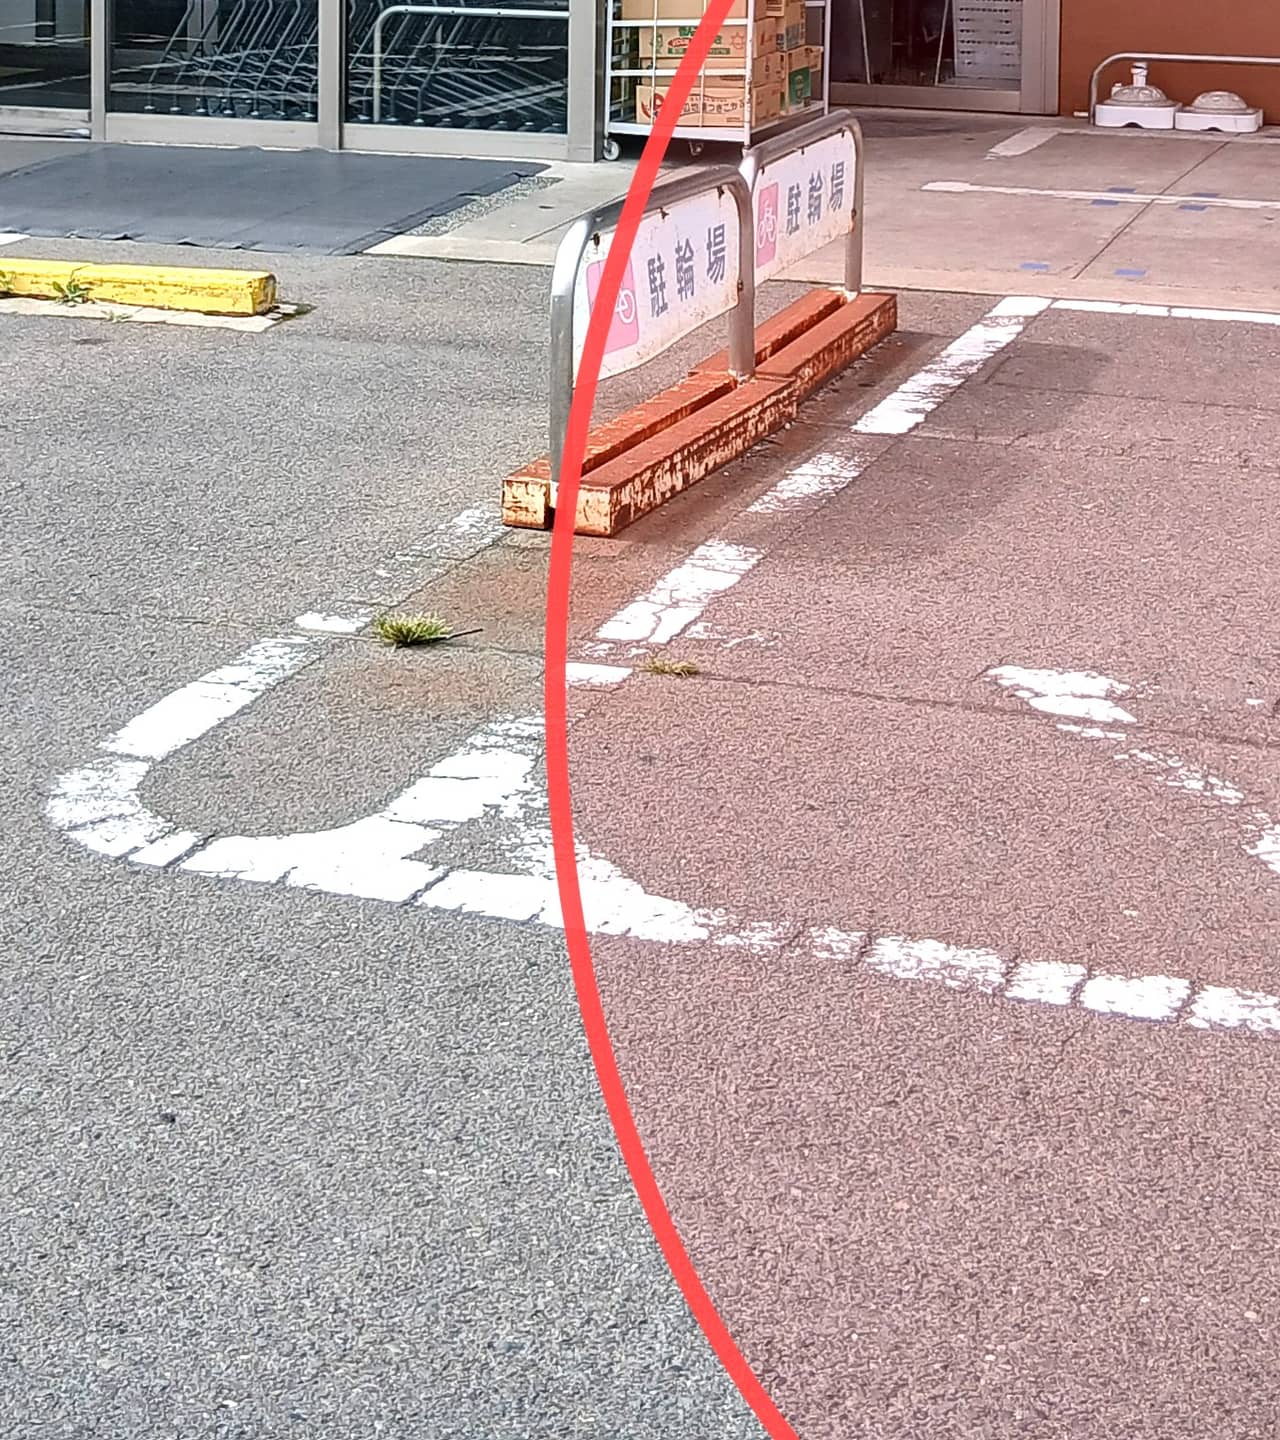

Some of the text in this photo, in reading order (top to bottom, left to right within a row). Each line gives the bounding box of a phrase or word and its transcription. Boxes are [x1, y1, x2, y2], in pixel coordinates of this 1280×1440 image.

[785, 161, 845, 237] 駐輪場
[648, 223, 726, 317] 駐輪場
